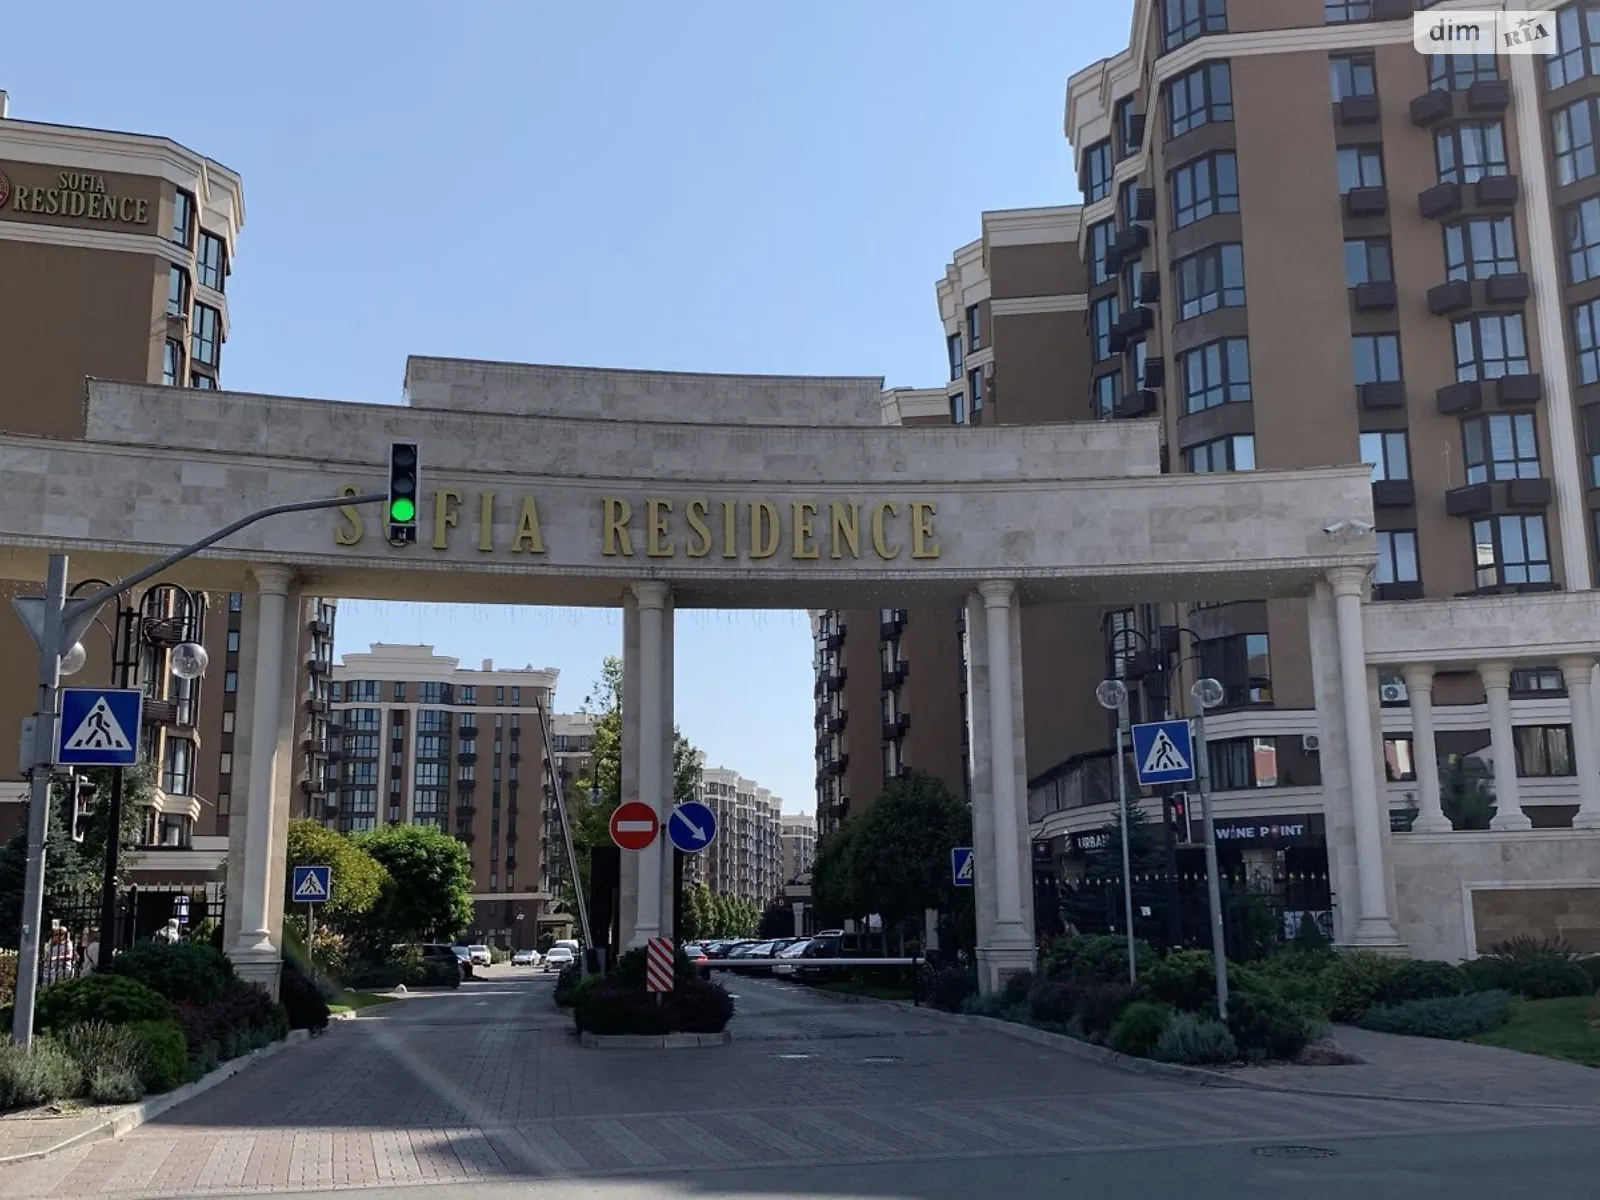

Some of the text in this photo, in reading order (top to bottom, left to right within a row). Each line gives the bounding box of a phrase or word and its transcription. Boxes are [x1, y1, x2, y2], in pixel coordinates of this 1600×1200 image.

[58, 171, 106, 193] SOFIA
[12, 185, 149, 223] RESIDENCE
[335, 483, 941, 559] SFIA RESIDENCE
